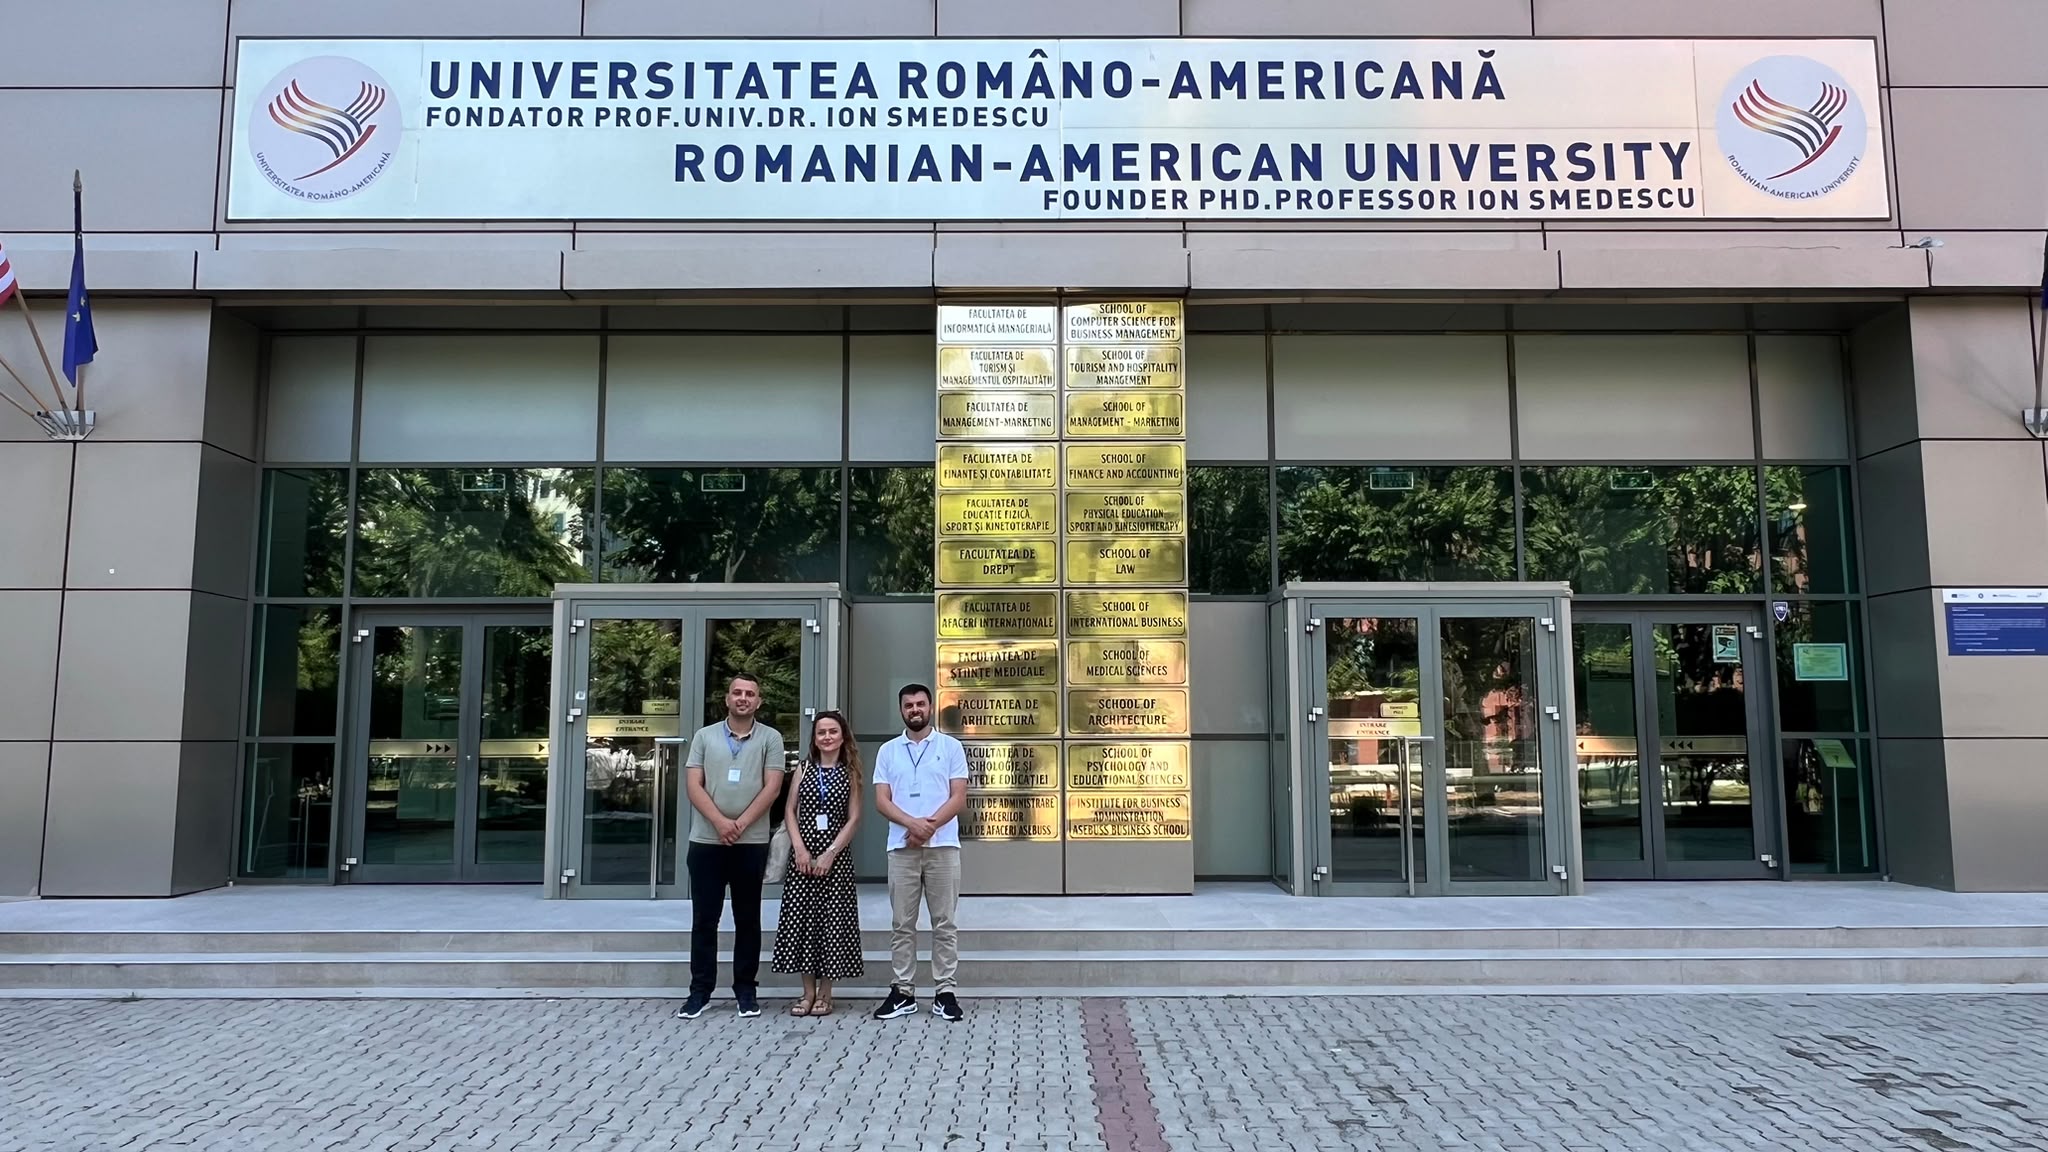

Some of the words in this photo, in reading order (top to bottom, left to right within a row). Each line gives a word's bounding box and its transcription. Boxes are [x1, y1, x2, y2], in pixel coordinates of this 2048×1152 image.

[430, 61, 879, 100] UNIVERSITATEA
[898, 48, 1506, 100] ROMÂNO-AMERICANĂ
[426, 106, 584, 128] FONDATOR
[595, 106, 816, 128] PROF.UNIV.DR.
[827, 106, 877, 128] ION
[886, 106, 1048, 128] SMEDESCU
[674, 142, 1323, 183] ROMANIAN-AMERICAN
[1345, 142, 1691, 183] UNIVERSITY
[256, 152, 305, 198] UNIVERSITATEA
[306, 151, 391, 200] ROMÂNO-AMERICANĂ
[1728, 154, 1819, 199] ROMANIAN-AMERICAN
[1821, 155, 1860, 194] UNIVERSITY
[1043, 189, 1189, 211] FOUNDER
[1199, 189, 1457, 211] PHD.PROFESSOR
[1467, 189, 1519, 211] ION
[1529, 187, 1695, 211] SMEDESCU
[969, 309, 1015, 319] FACULTATEA
[1017, 309, 1027, 319] DE
[1100, 304, 1134, 314] SCHOOL
[1136, 304, 1146, 314] OF
[1071, 317, 1119, 326] COMPUTER
[1121, 317, 1156, 326] SCIENCE
[1159, 317, 1176, 327] FOR
[944, 323, 996, 333] INFORMATICĂ
[998, 323, 1051, 333] MANAGERIALĂ
[1071, 329, 1113, 339] BUSINESS
[1115, 329, 1176, 339] MANAGEMENT
[971, 351, 1013, 360] FACULTATEA
[1016, 351, 1024, 360] DE
[1102, 350, 1132, 360] SCHOOL
[1135, 350, 1145, 360] OF
[979, 363, 1006, 372] TURISM
[1008, 363, 1015, 374] ȘI
[1070, 363, 1106, 372] TOURISM
[1108, 363, 1125, 372] AND
[1127, 363, 1177, 373] HOSPITALITY
[943, 375, 1001, 385] MANAGEMENTUL
[1097, 376, 1151, 385] MANAGEMENT
[966, 402, 1015, 412] FACULTATEA
[1018, 402, 1028, 412] DE
[1103, 402, 1134, 411] SCHOOL
[1136, 402, 1145, 411] OF
[943, 417, 1051, 427] MANAGEMENT-MARKETING
[1070, 417, 1124, 427] MANAGEMENT
[1134, 417, 1179, 427] MARKETING
[963, 454, 1019, 463] FACULTATEA
[1021, 454, 1032, 463] DE
[1101, 454, 1133, 463] SCHOOL
[1136, 454, 1146, 463] OF
[944, 469, 977, 480] FINANȚE
[980, 470, 988, 480] ȘI
[990, 469, 1051, 478] CONTABILITATE
[1070, 469, 1104, 479] FINANCE
[1106, 469, 1123, 479] AND
[1126, 469, 1179, 479] ACCOUNTING
[967, 499, 1016, 508] FACULTATEA
[1018, 498, 1028, 507] DE
[1104, 496, 1134, 505] SCHOOL
[1136, 496, 1144, 505] OF
[1084, 509, 1119, 519] PHYSICAL
[946, 522, 973, 531] SPORT
[975, 522, 984, 533] ȘI
[986, 521, 1050, 530] KINETOTERAPIE
[1070, 522, 1095, 531] SPORT
[1097, 522, 1113, 531] AND
[1115, 522, 1179, 531] KINESIOTHERAPY
[960, 549, 1020, 559] FACULTATEA
[1023, 549, 1035, 558] DE
[1100, 549, 1135, 559] SCHOOL
[1139, 549, 1151, 558] OF
[983, 565, 1016, 575] DREPT
[1115, 565, 1136, 574] LAW
[965, 603, 1017, 612] FACULTATEA
[1020, 602, 1030, 612] DE
[1102, 602, 1135, 612] SCHOOL
[1139, 602, 1149, 611] OF
[942, 618, 977, 627] AFACERI
[980, 618, 1053, 630] INTERNAȚIONALE
[1070, 618, 1138, 627] INTERNATIONAL
[1141, 618, 1183, 627] BUSINESS
[959, 651, 1019, 662] FACULTATEA
[1023, 651, 1036, 660] DE
[1103, 650, 1136, 660] SCHOOL
[1139, 650, 1149, 660] OF
[994, 666, 1045, 676] MEDICALE
[1086, 666, 1123, 676] MEDICAL
[1127, 666, 1168, 676] SCIENCES
[958, 699, 1022, 709] FACULTATEA
[1025, 699, 1038, 709] DE
[1099, 699, 1139, 709] SCHOOL
[1144, 699, 1156, 709] OF
[1088, 715, 1167, 725] ARCHITECTURE
[1023, 748, 1034, 757] DE
[1102, 748, 1138, 758] SCHOOL
[1141, 748, 1152, 757] OF
[968, 761, 1020, 771] SIHOLOGIE
[1023, 761, 1031, 773] ȘI
[1087, 762, 1146, 771] PSYCHOLOGY
[1149, 762, 1169, 771] AND
[967, 775, 996, 787] NȚELE
[1000, 775, 1048, 787] EDUCAȚIEI
[1074, 775, 1137, 785] EDUCATIONAL
[1139, 775, 1183, 785] SCIENCES
[988, 798, 997, 808] DE
[999, 798, 1054, 808] ADMINISTRARE
[1078, 799, 1119, 808] INSTITUTE
[1123, 799, 1139, 808] FOR
[1141, 799, 1181, 808] BUSINESS
[973, 812, 977, 821] A
[980, 812, 1024, 821] AFACERILOR
[1093, 811, 1164, 822] ADMINISTRATION
[960, 826, 973, 835] ALA
[976, 825, 984, 835] DE
[986, 825, 1017, 835] AFACERI
[1020, 825, 1051, 835] ASEBUSS
[1073, 825, 1108, 835] ASEBUSS
[1111, 825, 1151, 835] BUSINESS
[1154, 825, 1186, 835] SCHOOL
